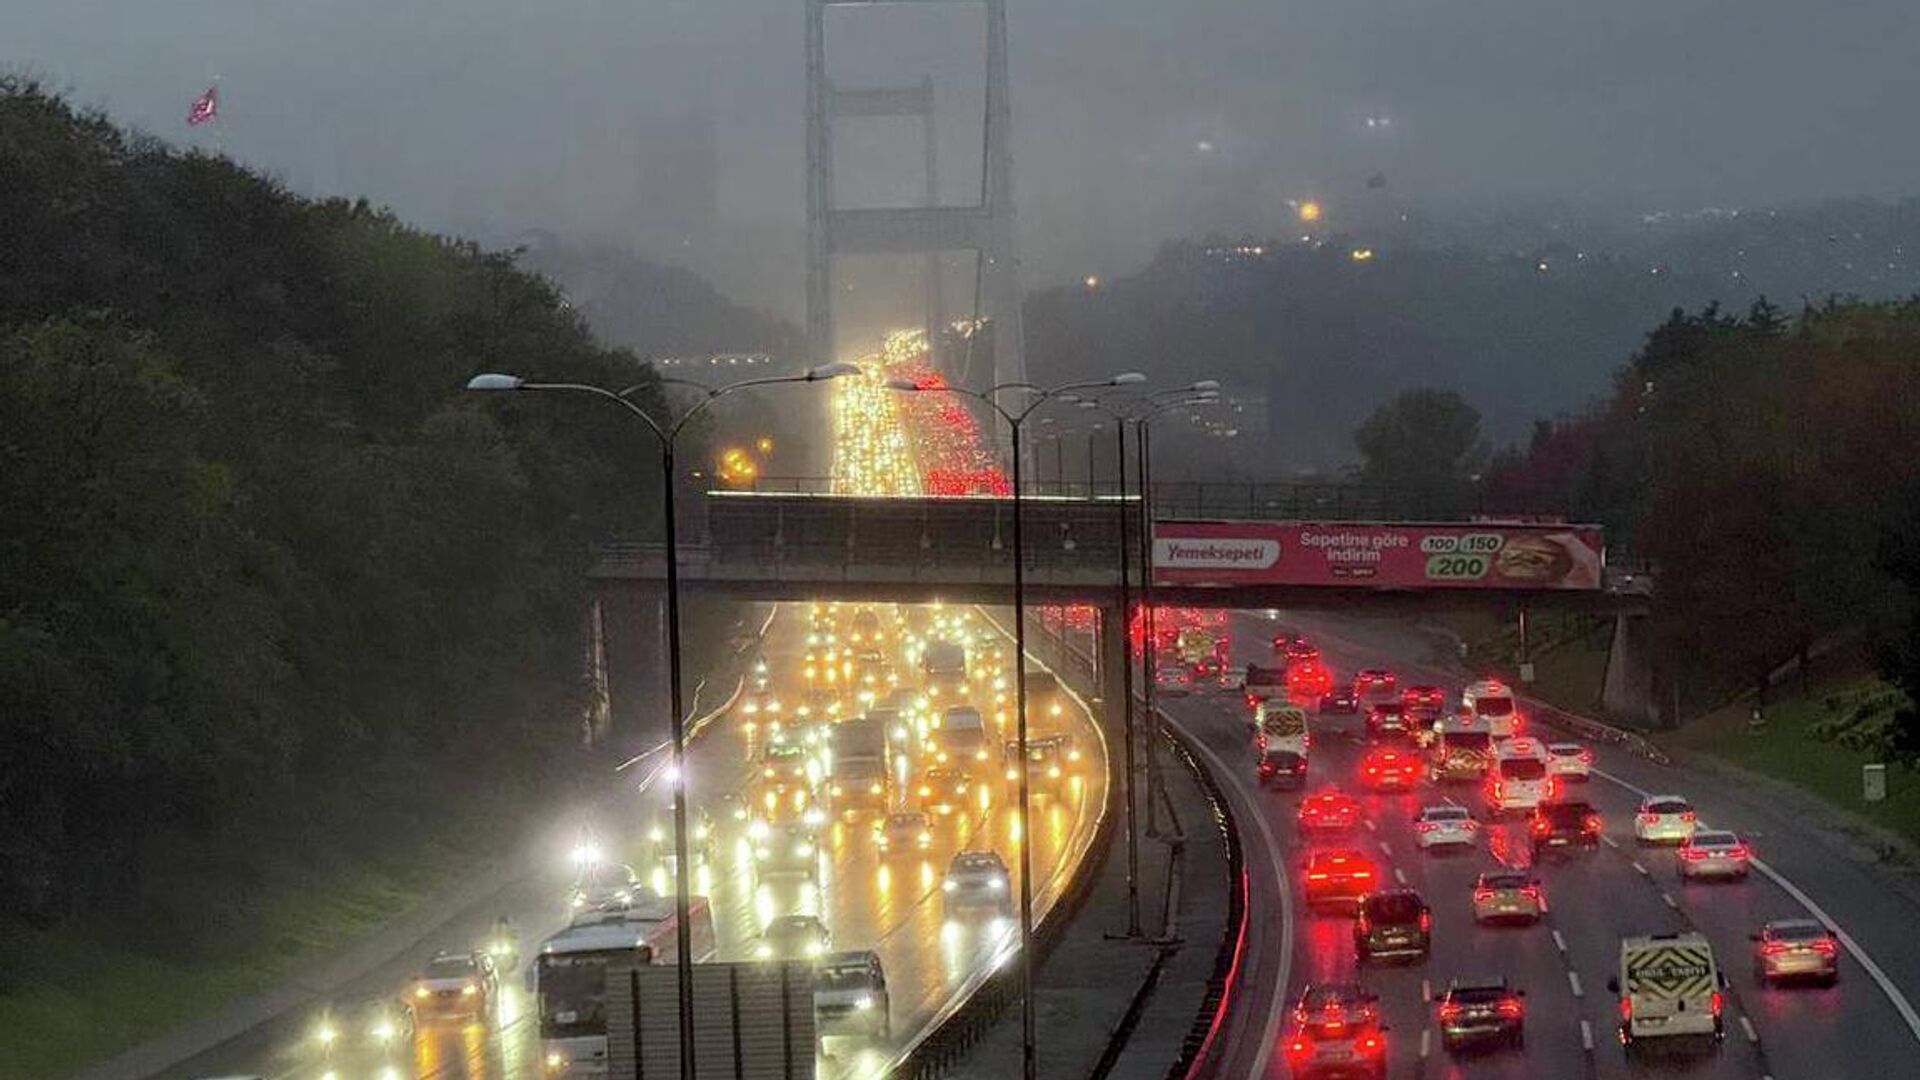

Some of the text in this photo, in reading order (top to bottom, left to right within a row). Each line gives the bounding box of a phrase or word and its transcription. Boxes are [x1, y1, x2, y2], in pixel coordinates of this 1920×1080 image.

[1300, 532, 1409, 549] Sepetine göre
[1168, 544, 1264, 561] Yemeksepeti
